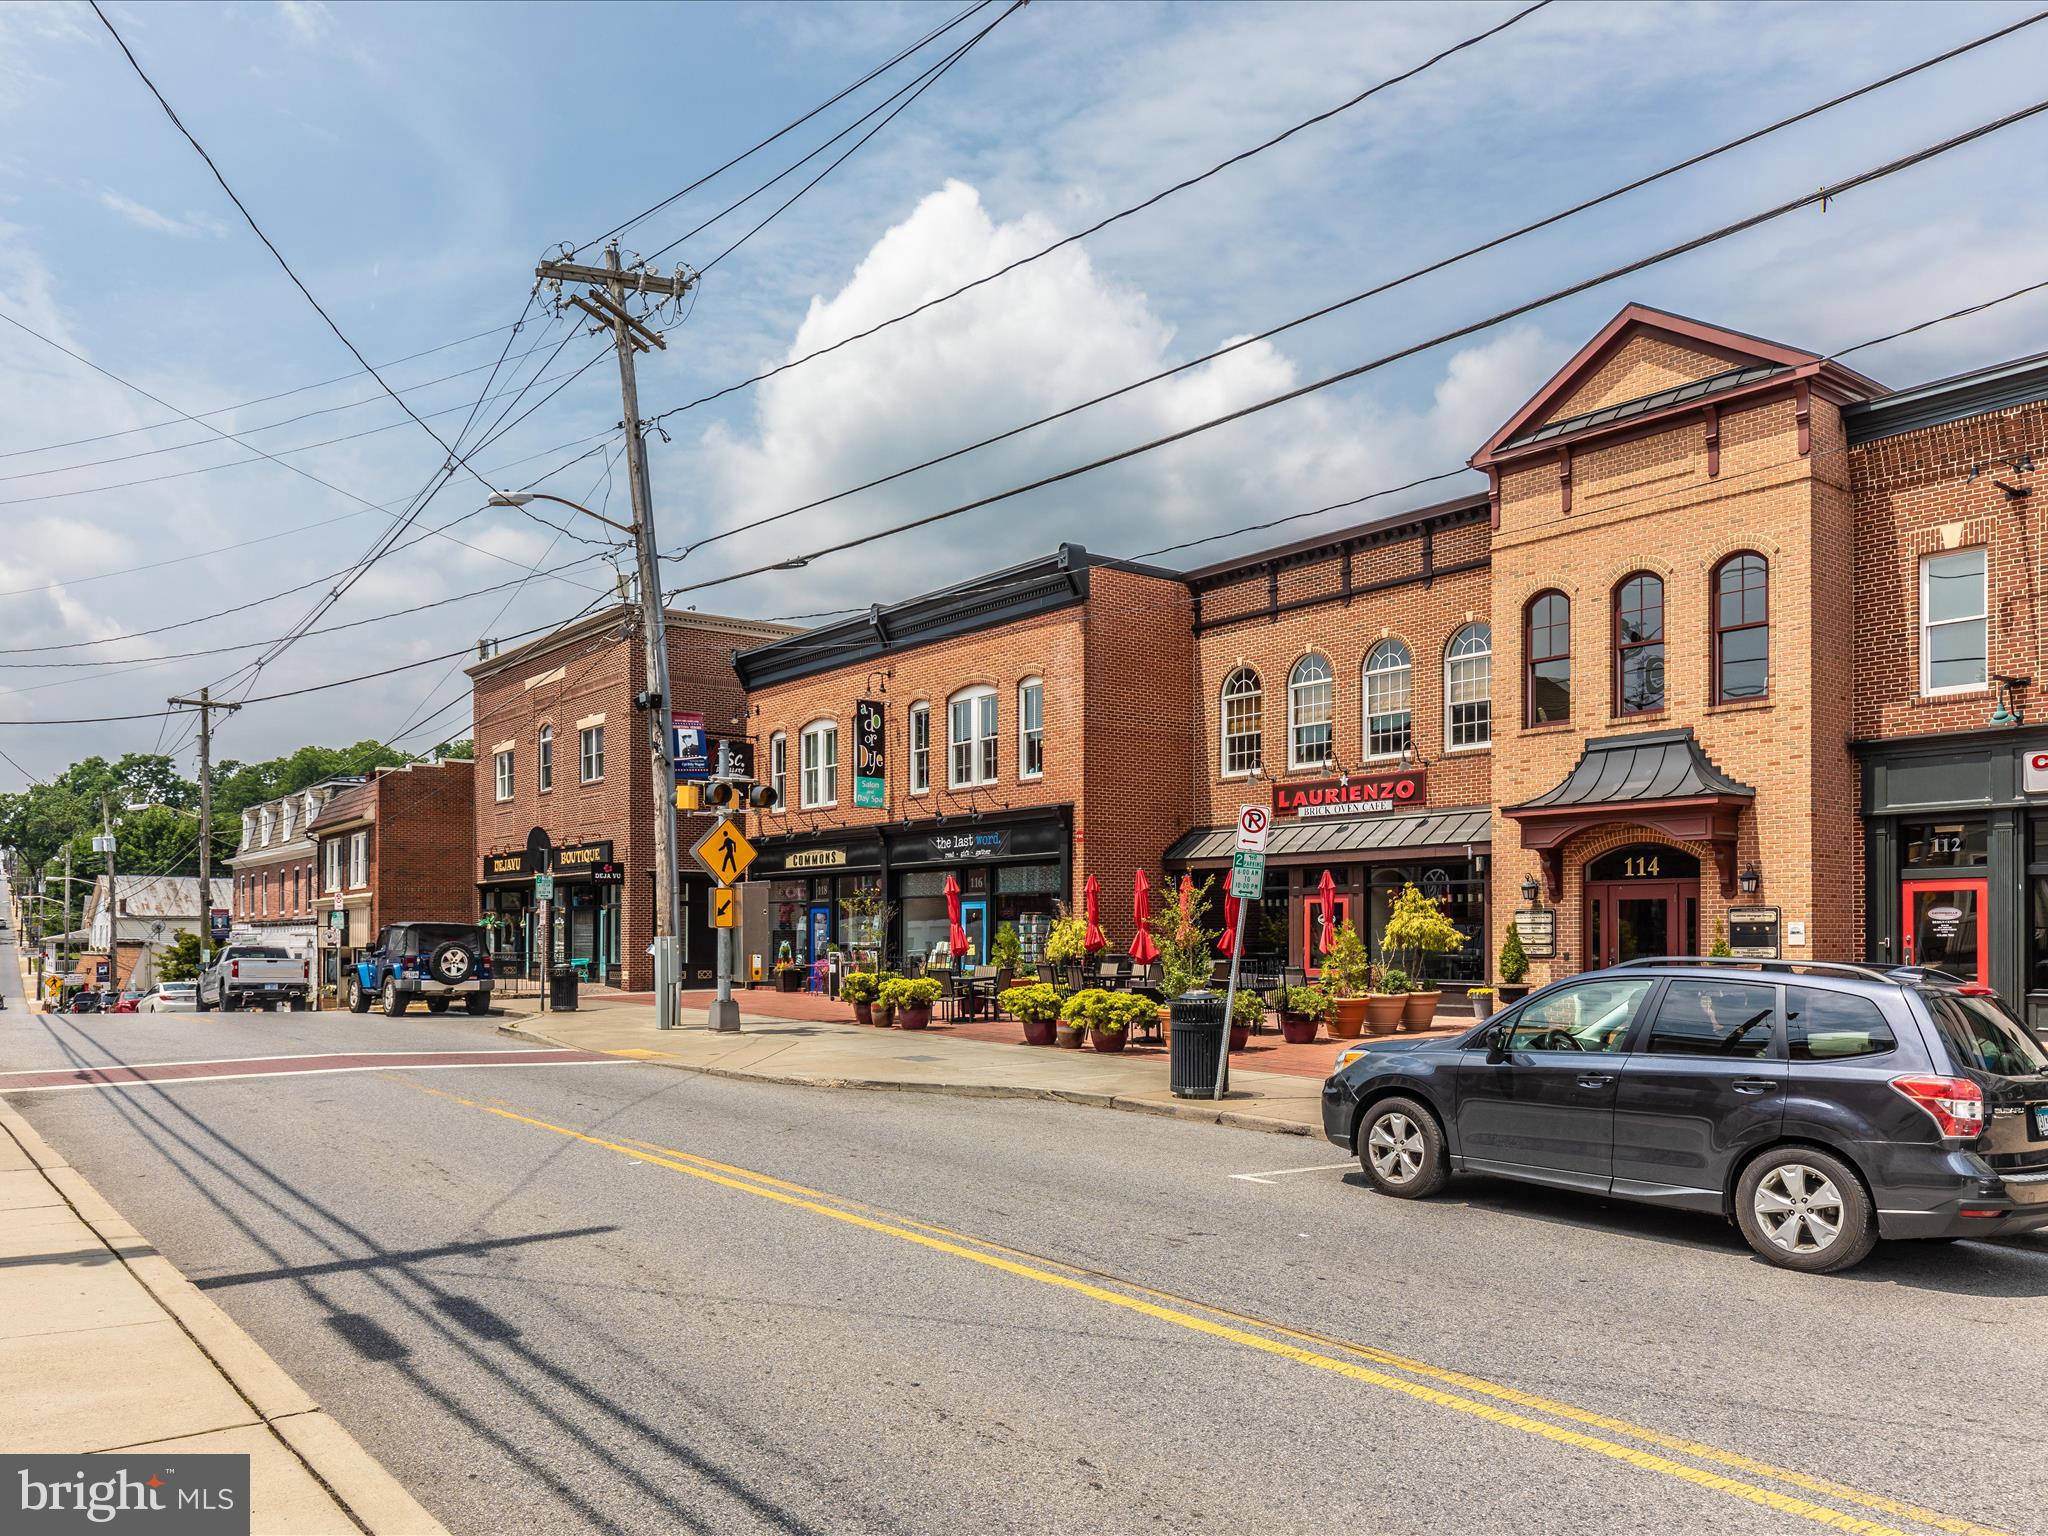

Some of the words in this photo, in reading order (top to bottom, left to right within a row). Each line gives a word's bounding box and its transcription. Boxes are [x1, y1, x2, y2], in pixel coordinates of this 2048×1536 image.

[864, 733, 877, 746] or
[859, 744, 883, 775] Dye
[862, 780, 880, 789] Salon
[858, 794, 868, 803] Day
[871, 795, 883, 803] Spa
[1278, 779, 1415, 808] LAURIENZO
[1304, 806, 1331, 816] BRICK
[1334, 803, 1360, 814] OVEN
[1362, 801, 1387, 812] CAFE
[936, 836, 952, 849] the
[954, 834, 974, 848] last
[975, 832, 1001, 845] word.
[1934, 837, 1961, 853] 112
[560, 847, 601, 865] BOUTIQUE
[792, 851, 837, 867] COMMONS
[1236, 854, 1244, 867] 2
[1624, 856, 1660, 876] 114
[818, 884, 829, 896] 118
[970, 876, 984, 889] 116
